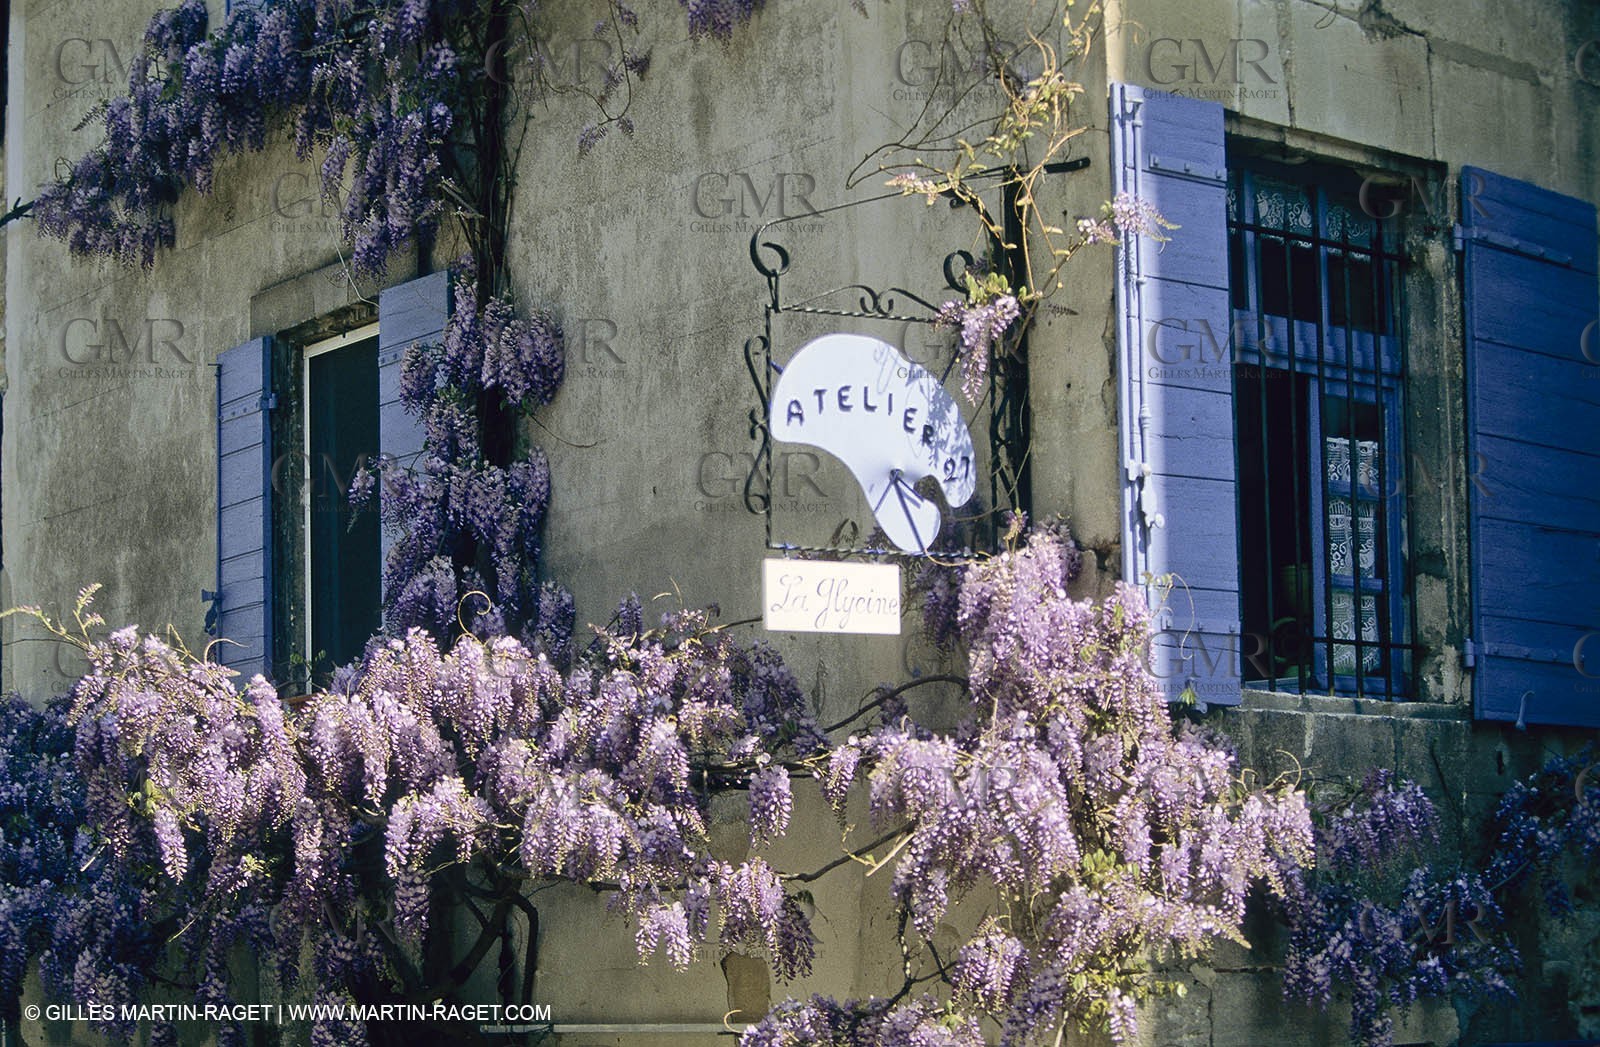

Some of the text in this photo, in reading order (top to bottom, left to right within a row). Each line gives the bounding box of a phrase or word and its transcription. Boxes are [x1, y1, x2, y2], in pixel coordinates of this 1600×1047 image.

[786, 385, 970, 483] ATELIER 27
[770, 573, 809, 614] La
